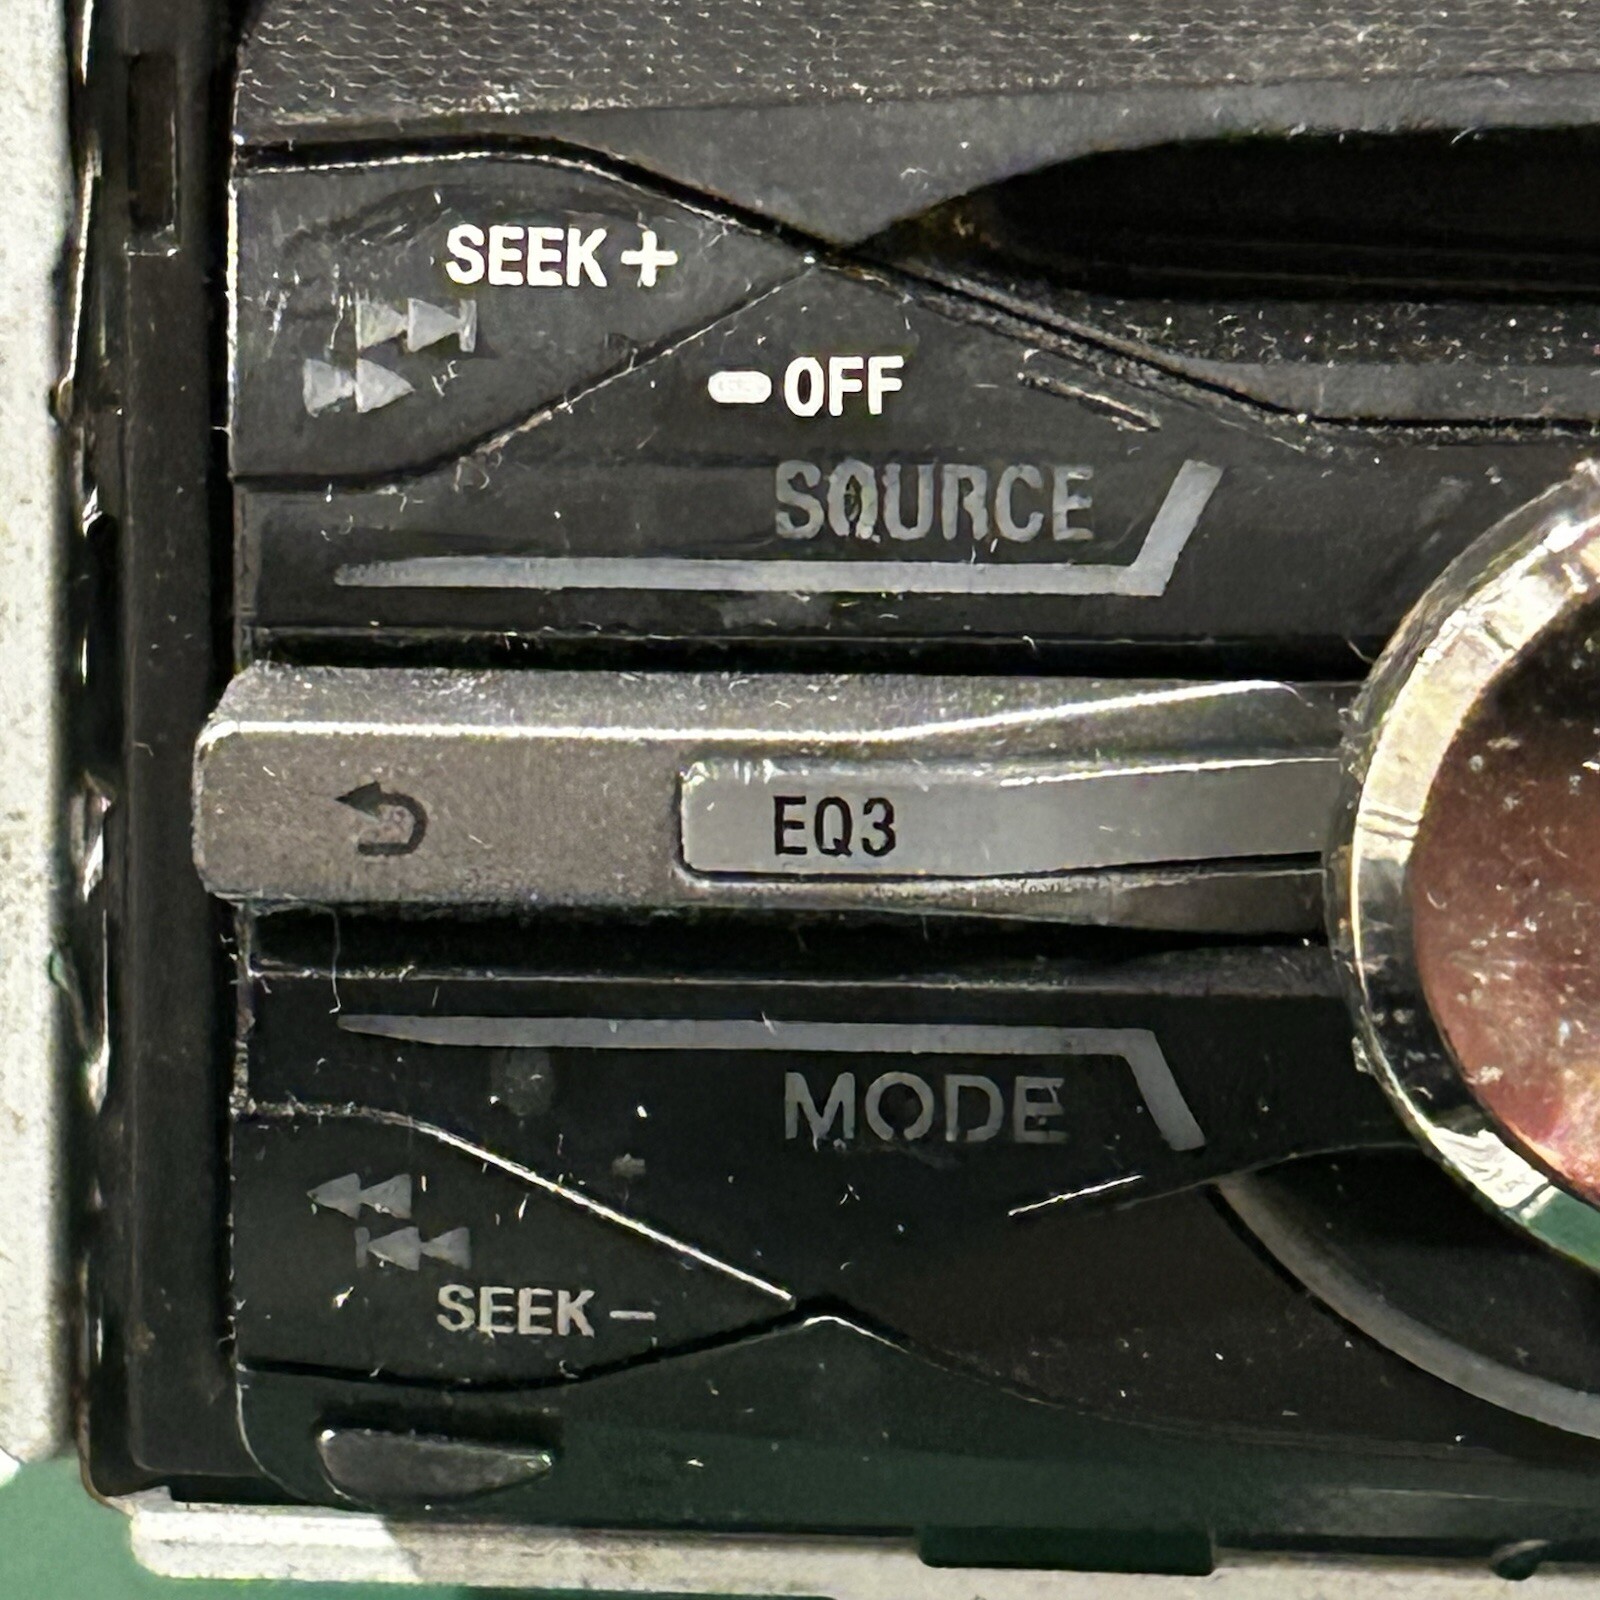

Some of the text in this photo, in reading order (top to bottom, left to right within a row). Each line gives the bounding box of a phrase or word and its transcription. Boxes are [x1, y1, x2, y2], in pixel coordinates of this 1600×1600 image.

[445, 223, 608, 288] SEEK
[782, 355, 905, 417] OFF
[775, 458, 1094, 542] SOURCE
[773, 793, 898, 858] EQ3
[783, 1070, 1067, 1146] MODE
[436, 1284, 595, 1337] SEEK
